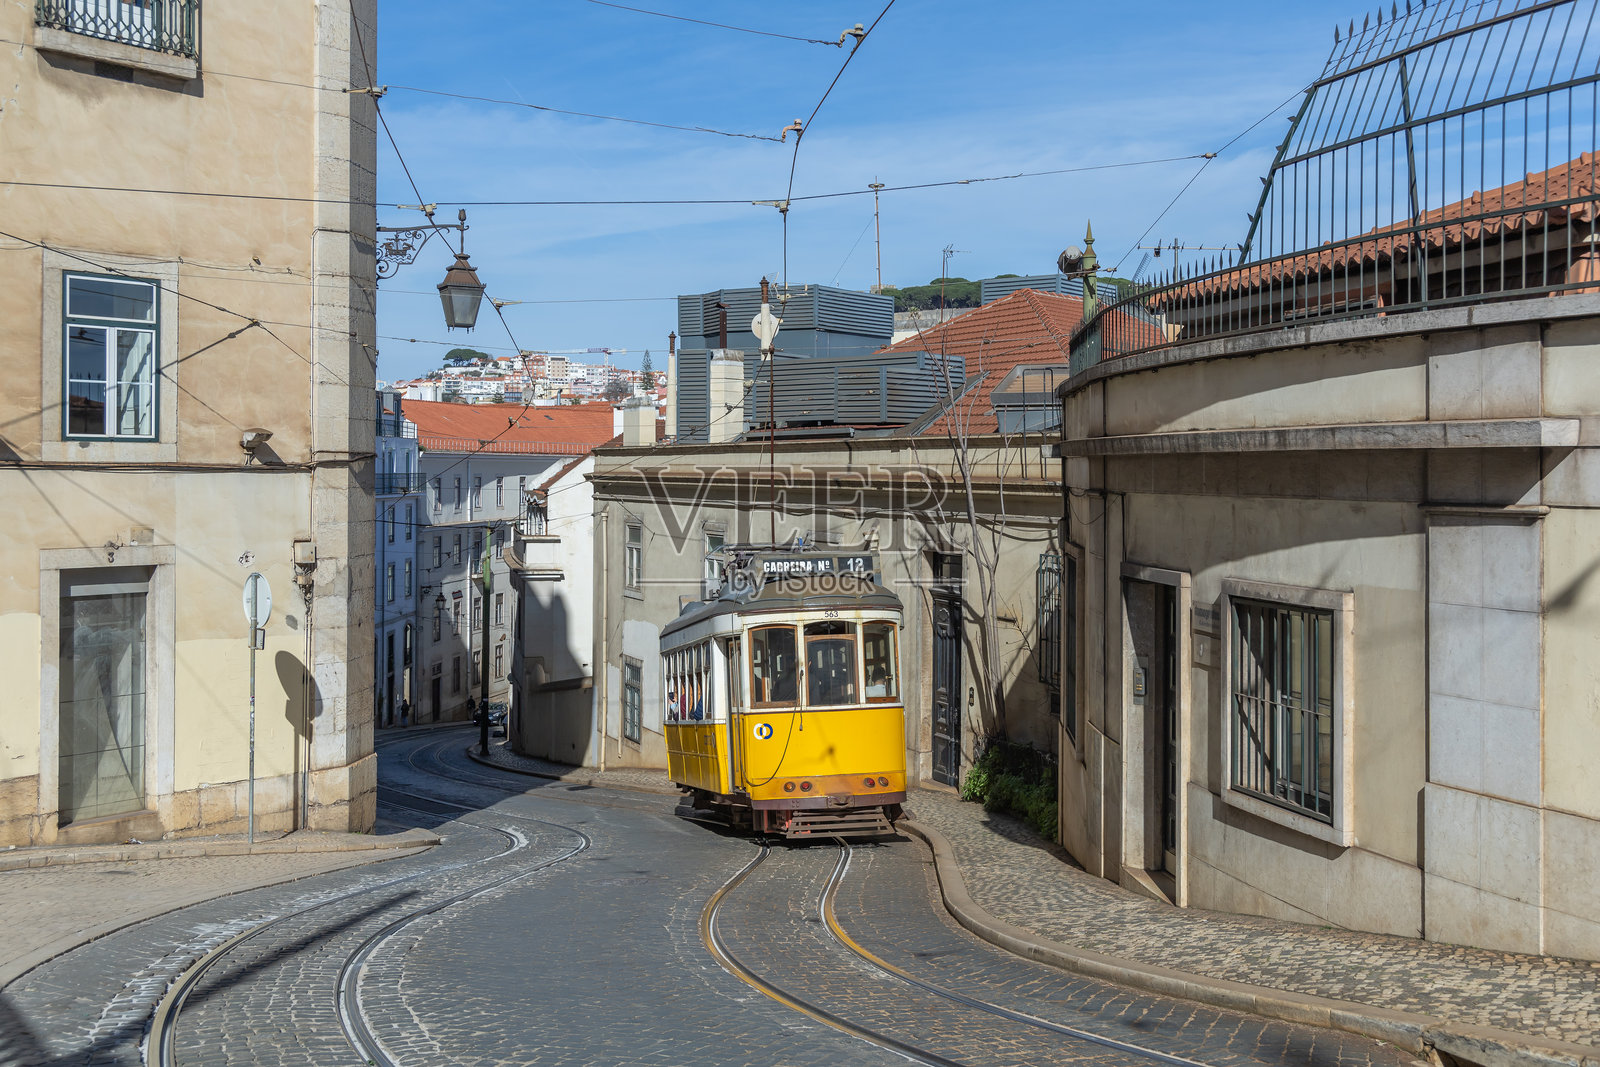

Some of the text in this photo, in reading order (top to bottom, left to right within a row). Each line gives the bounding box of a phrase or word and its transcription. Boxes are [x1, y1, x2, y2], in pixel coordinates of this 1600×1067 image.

[108, 552, 115, 563] 3
[763, 560, 813, 573] CARREIRA
[847, 557, 864, 572] 12
[824, 610, 839, 618] 563
